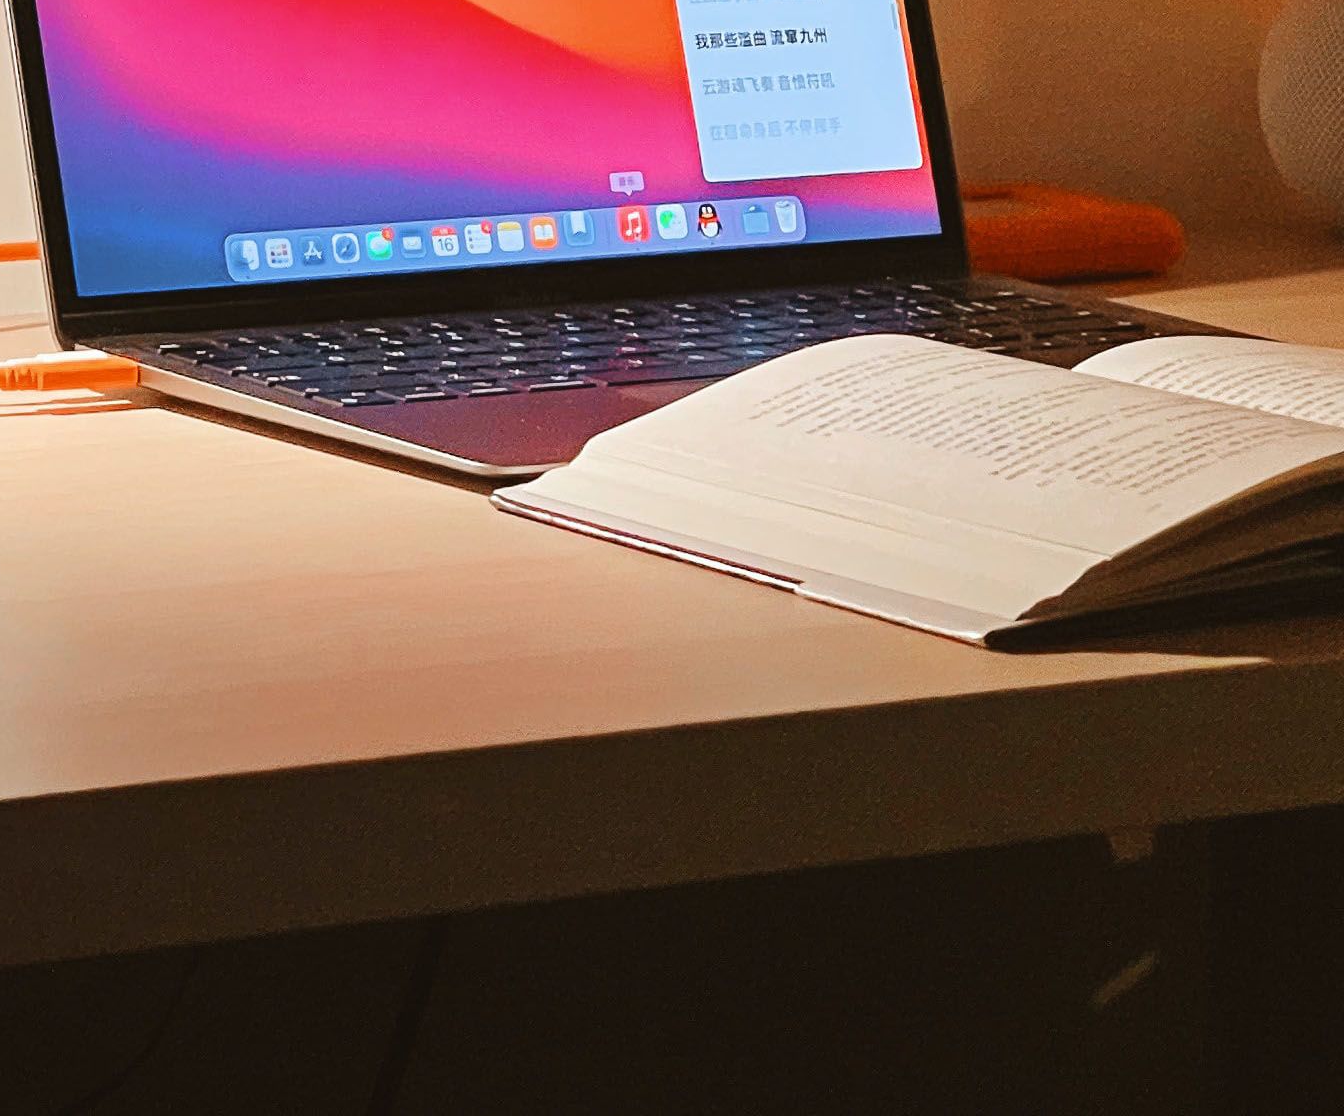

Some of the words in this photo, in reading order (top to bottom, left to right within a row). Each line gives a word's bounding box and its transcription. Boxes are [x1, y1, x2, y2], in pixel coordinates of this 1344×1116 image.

[694, 30, 767, 50] 我那些滥曲
[770, 27, 828, 45] 流窜九州
[437, 236, 454, 253] 16
